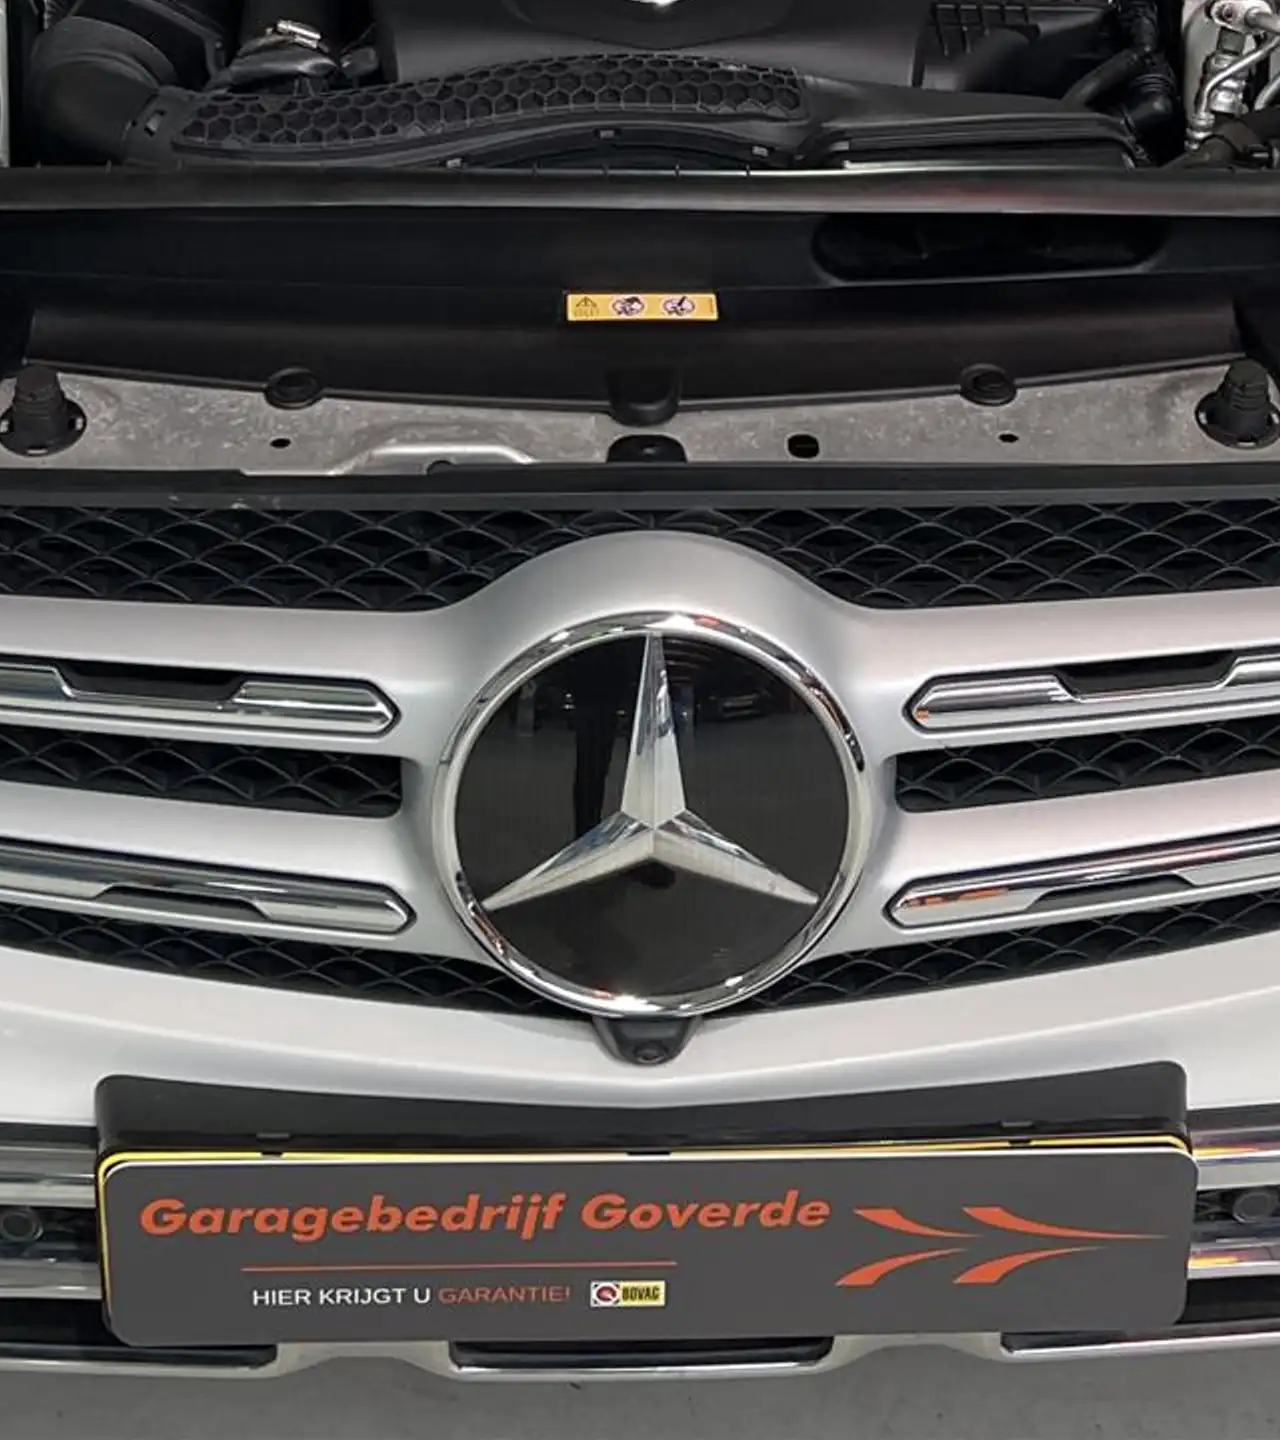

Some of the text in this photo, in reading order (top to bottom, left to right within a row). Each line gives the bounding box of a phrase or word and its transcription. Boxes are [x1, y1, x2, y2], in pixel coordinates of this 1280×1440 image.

[140, 1189, 830, 1243] Garagebedrijf Goverde
[252, 1284, 571, 1307] HIER KRIJGT U GARANTIE!
